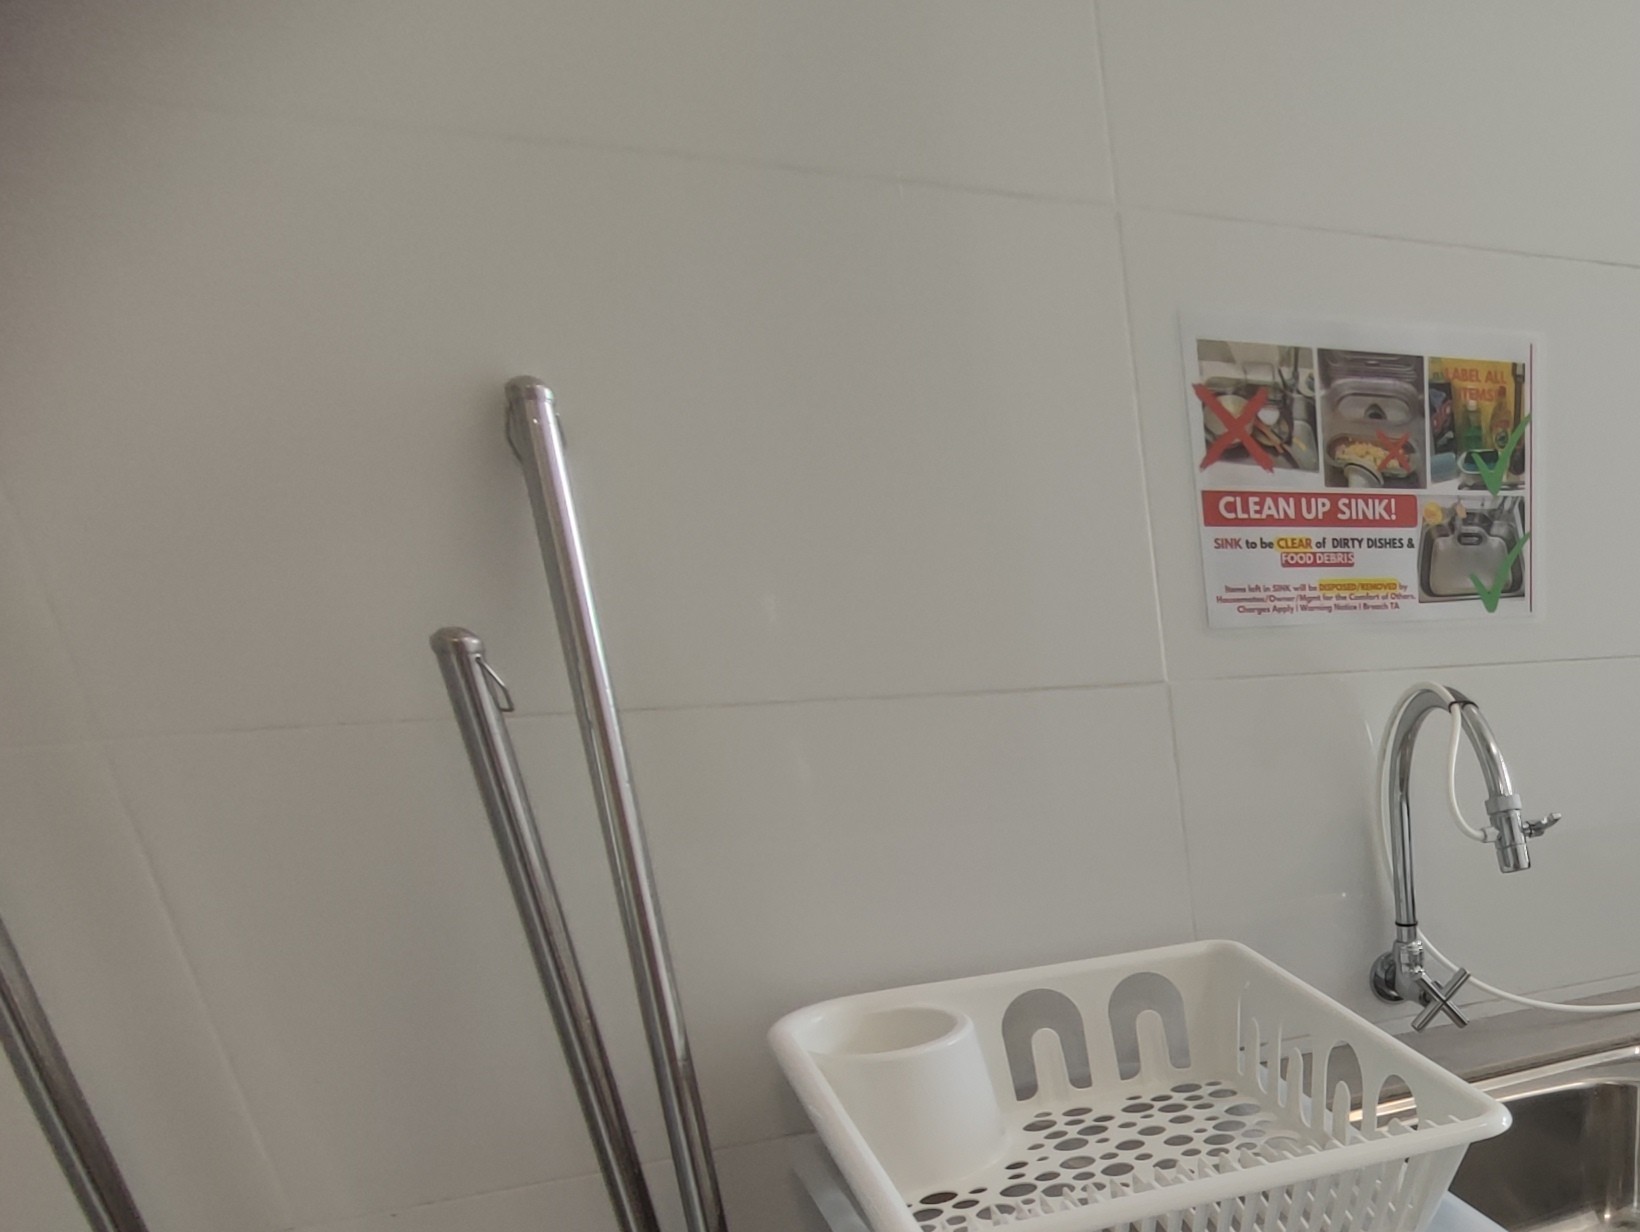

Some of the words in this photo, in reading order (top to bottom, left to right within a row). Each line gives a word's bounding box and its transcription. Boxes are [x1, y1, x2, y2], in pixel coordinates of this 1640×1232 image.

[1218, 496, 1296, 520] CLEAN
[1301, 497, 1333, 520] UP
[1336, 498, 1397, 521] SINK!
[1214, 538, 1242, 549] SINK
[1245, 539, 1257, 549] to
[1260, 538, 1274, 549] be
[1276, 538, 1313, 549] CLEAR
[1315, 537, 1327, 549] of
[1331, 538, 1364, 549] DIRTY
[1367, 538, 1404, 549] DISHES
[1406, 538, 1415, 549] &
[1282, 553, 1314, 564] FOOD
[1316, 552, 1354, 564] DEBRIS
